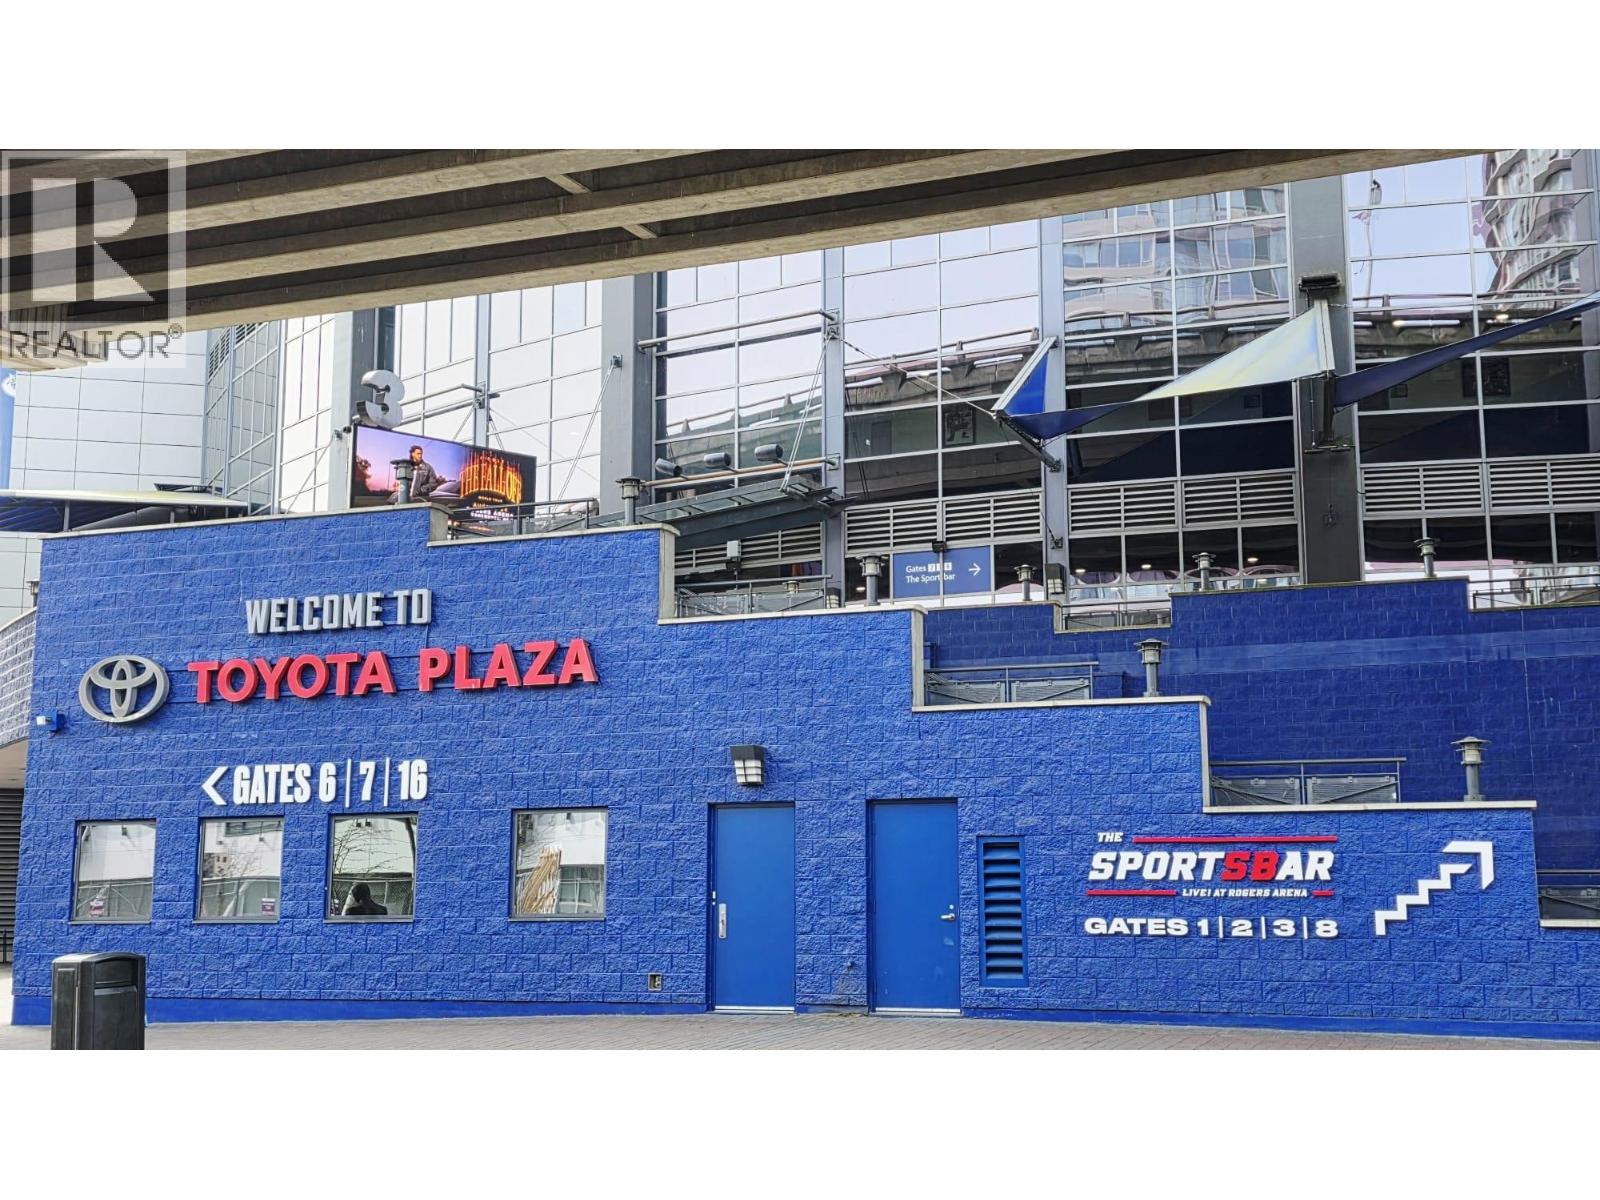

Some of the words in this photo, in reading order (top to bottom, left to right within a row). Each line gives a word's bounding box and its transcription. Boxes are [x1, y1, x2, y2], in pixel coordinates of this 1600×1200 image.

[361, 369, 405, 428] 3
[460, 463, 479, 498] THE
[905, 565, 926, 573] Gates
[905, 574, 920, 583] The
[246, 590, 384, 635] WELCOME
[393, 588, 433, 626] TO
[187, 651, 396, 704] TOYOTA
[418, 637, 599, 693] PLAZA
[232, 762, 311, 806] GATES
[1097, 832, 1124, 843] THE
[1088, 850, 1335, 881] SPORTSBAR
[1182, 888, 1212, 897] LIVE!
[1213, 888, 1227, 897] AT
[1228, 888, 1271, 897] ROGERS
[1272, 888, 1308, 897] ARENA
[1084, 917, 1189, 936] GATES
